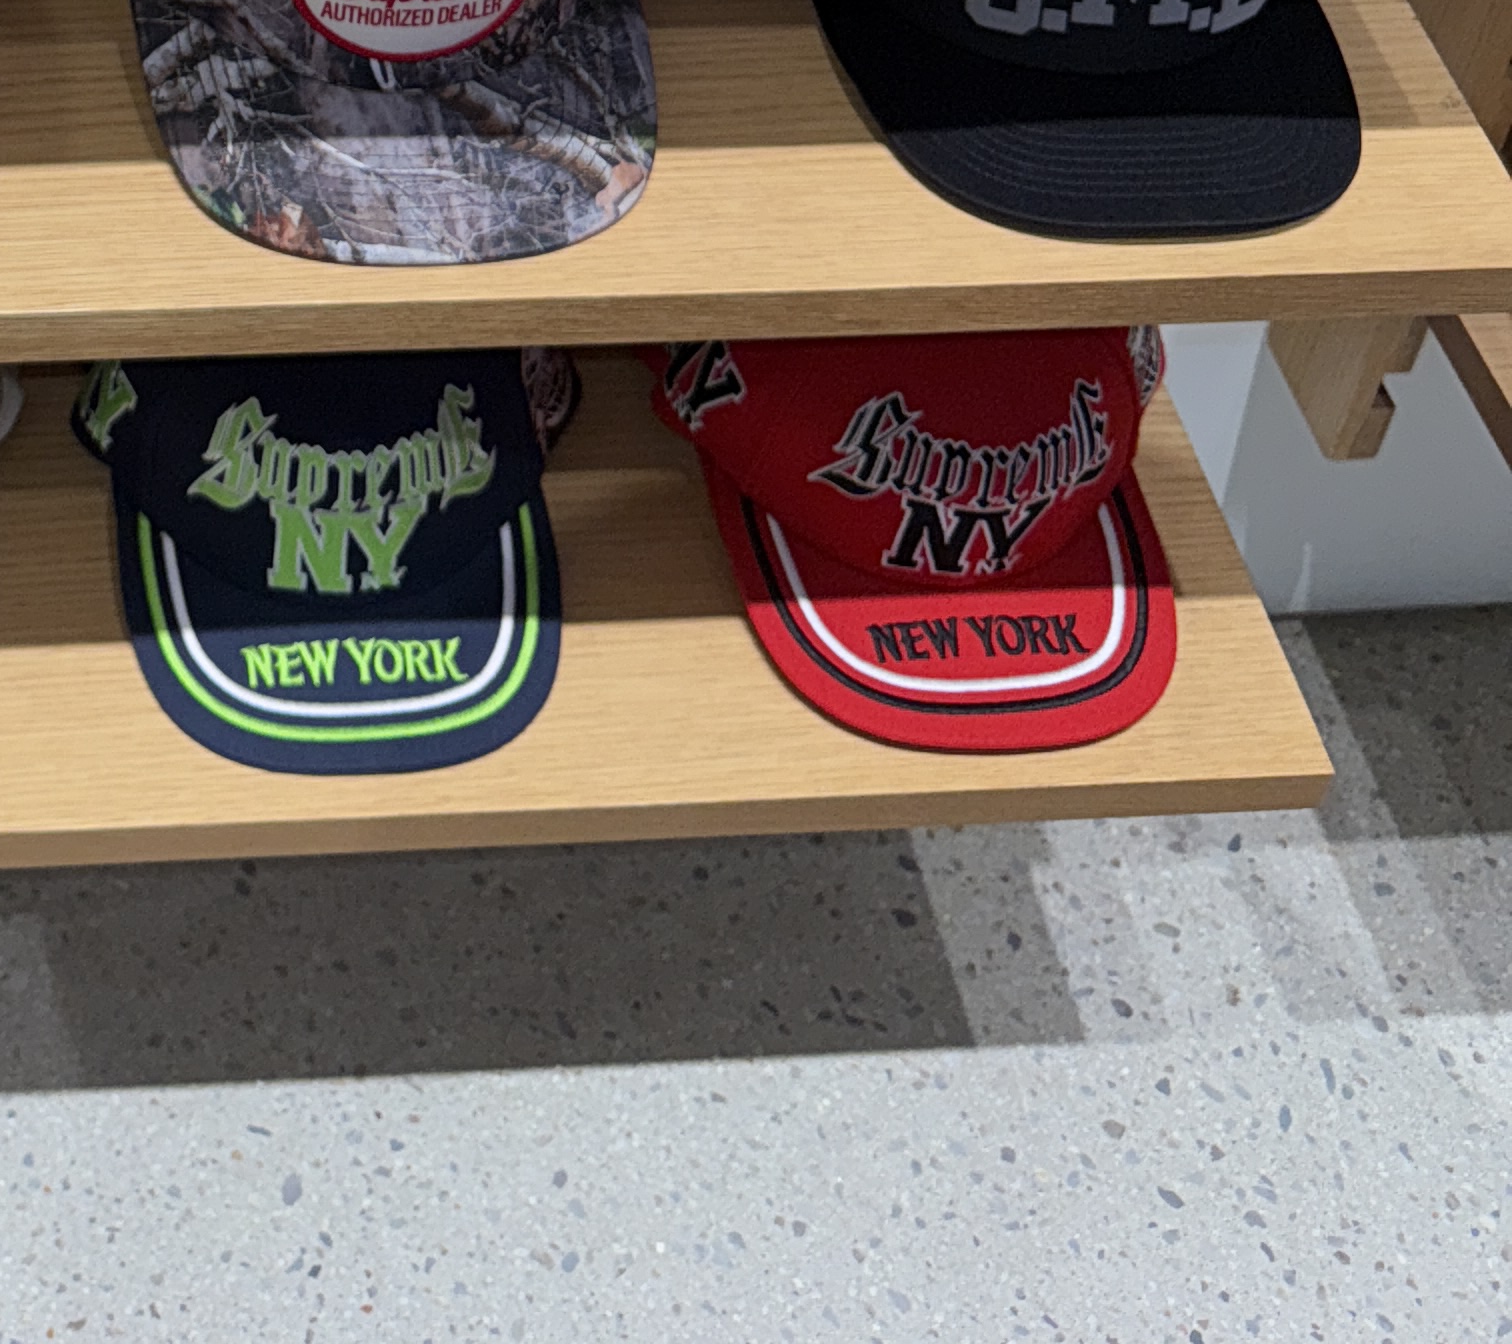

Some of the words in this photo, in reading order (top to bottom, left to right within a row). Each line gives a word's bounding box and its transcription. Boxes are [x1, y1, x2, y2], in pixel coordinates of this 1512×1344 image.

[321, 0, 434, 27] AUTHORIZED
[266, 494, 428, 596] NY
[881, 494, 1057, 574] NY
[240, 637, 339, 688] NEW
[341, 635, 469, 683] YORK
[866, 615, 958, 663] NEW
[962, 613, 1089, 657] YORK
